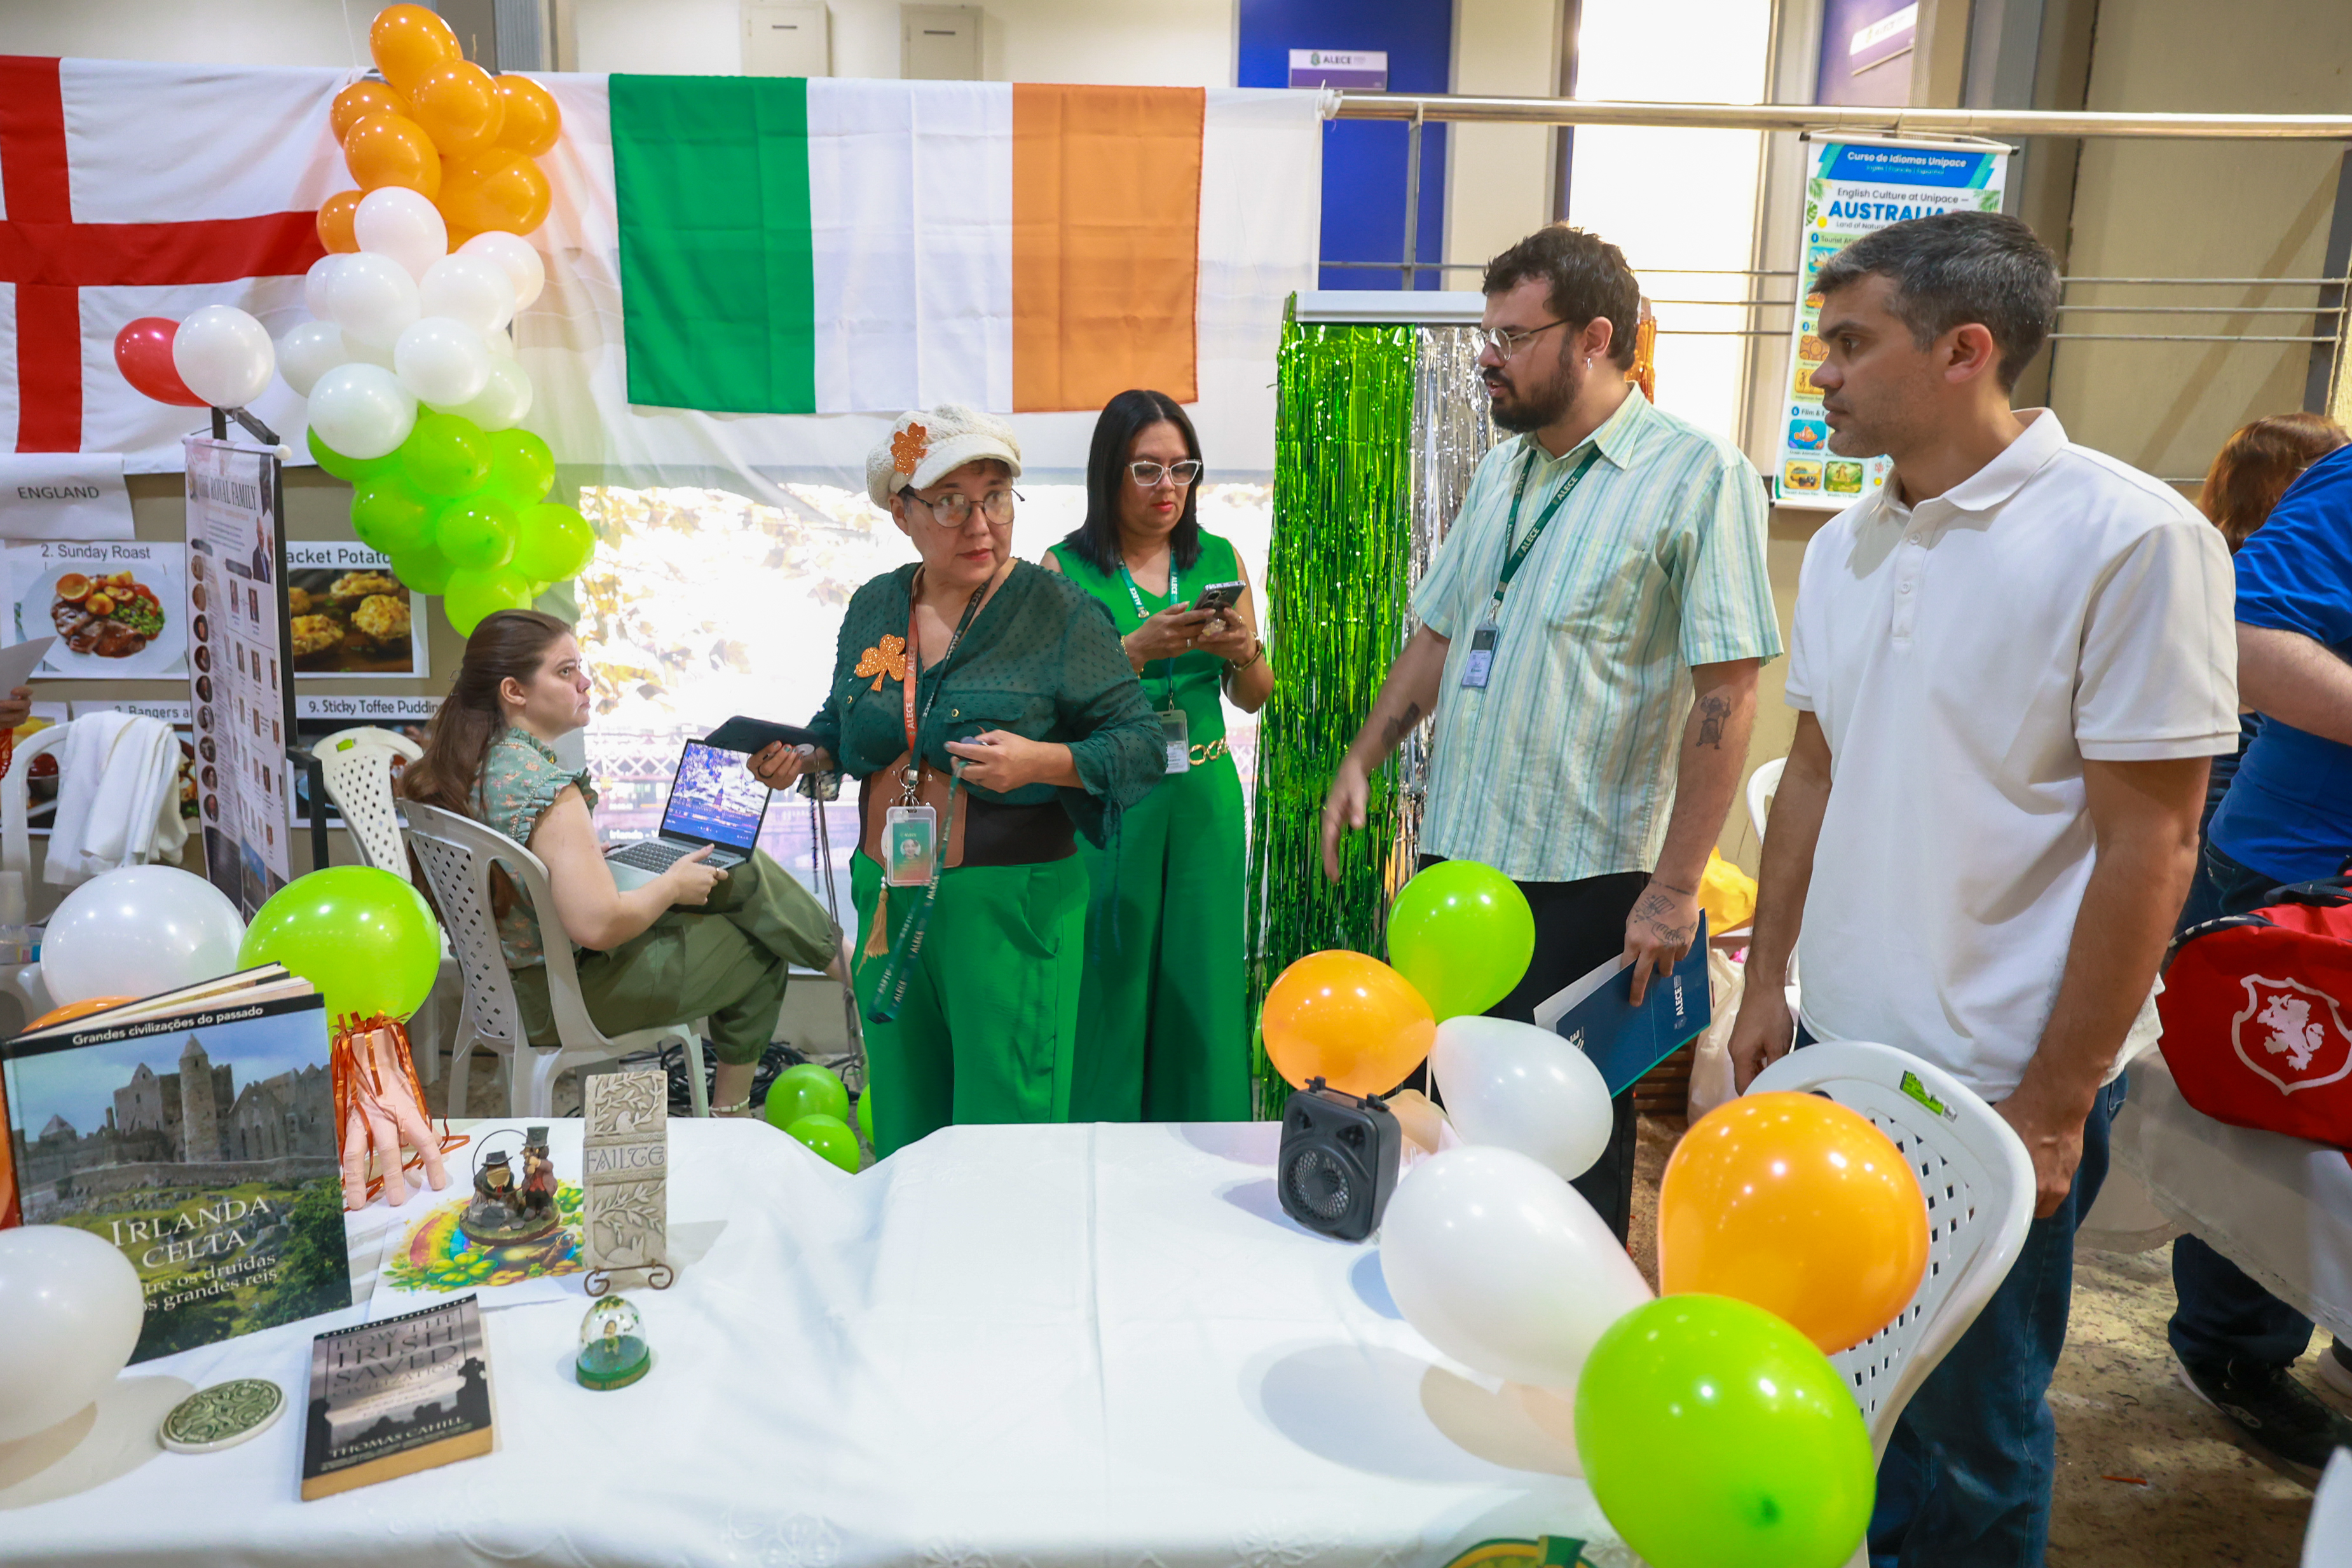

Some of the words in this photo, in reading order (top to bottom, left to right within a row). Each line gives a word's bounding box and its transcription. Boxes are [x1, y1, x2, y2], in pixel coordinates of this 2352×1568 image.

[1323, 55, 1351, 64] ALECE
[1847, 151, 1875, 162] Curso
[1877, 153, 1888, 162] de
[1889, 154, 1927, 165] Idiomas
[1929, 157, 1967, 168] Unipace
[1837, 187, 1870, 198] English
[1873, 189, 1906, 200] Culture
[1908, 192, 1918, 201] at
[1920, 193, 1959, 205] Unipace
[1821, 235, 1842, 243] Tourist
[17, 486, 99, 499] ENGLAND
[210, 477, 231, 504] ROYAL
[231, 481, 257, 511] FAMILY
[1557, 475, 1578, 501] ALECE
[41, 544, 53, 558] 2.
[58, 543, 107, 561] Sunday
[112, 545, 151, 559] Roast
[1521, 527, 1540, 553] ALECE
[286, 549, 332, 564] acket
[1129, 587, 1142, 606] ALECE
[907, 646, 916, 672] ALECE
[308, 700, 319, 713] 9.
[323, 699, 356, 715] Sticky
[359, 699, 394, 713] Toffee
[397, 700, 443, 714] Puddin
[906, 702, 915, 729] ALECE
[910, 930, 925, 953] ALECE
[893, 979, 907, 1003] ALECE
[1674, 986, 1685, 1016] ALECE
[72, 1028, 126, 1046] Grandes
[128, 1016, 195, 1037] civilizações
[197, 1011, 213, 1025] do
[215, 1006, 264, 1025] passado
[586, 1145, 665, 1173] FAILTE
[108, 1195, 271, 1247] IRLANDA
[142, 1229, 247, 1269] CELTA
[177, 1273, 198, 1286] os
[203, 1253, 276, 1280] druidas
[163, 1278, 239, 1311] grandes
[245, 1267, 278, 1286] reis
[336, 1328, 397, 1350] HOW
[407, 1312, 455, 1333] THE
[338, 1326, 453, 1368] IRISH
[334, 1345, 458, 1387] SAVED
[329, 1432, 403, 1458] THOMAS
[406, 1415, 465, 1438] CAHILL
